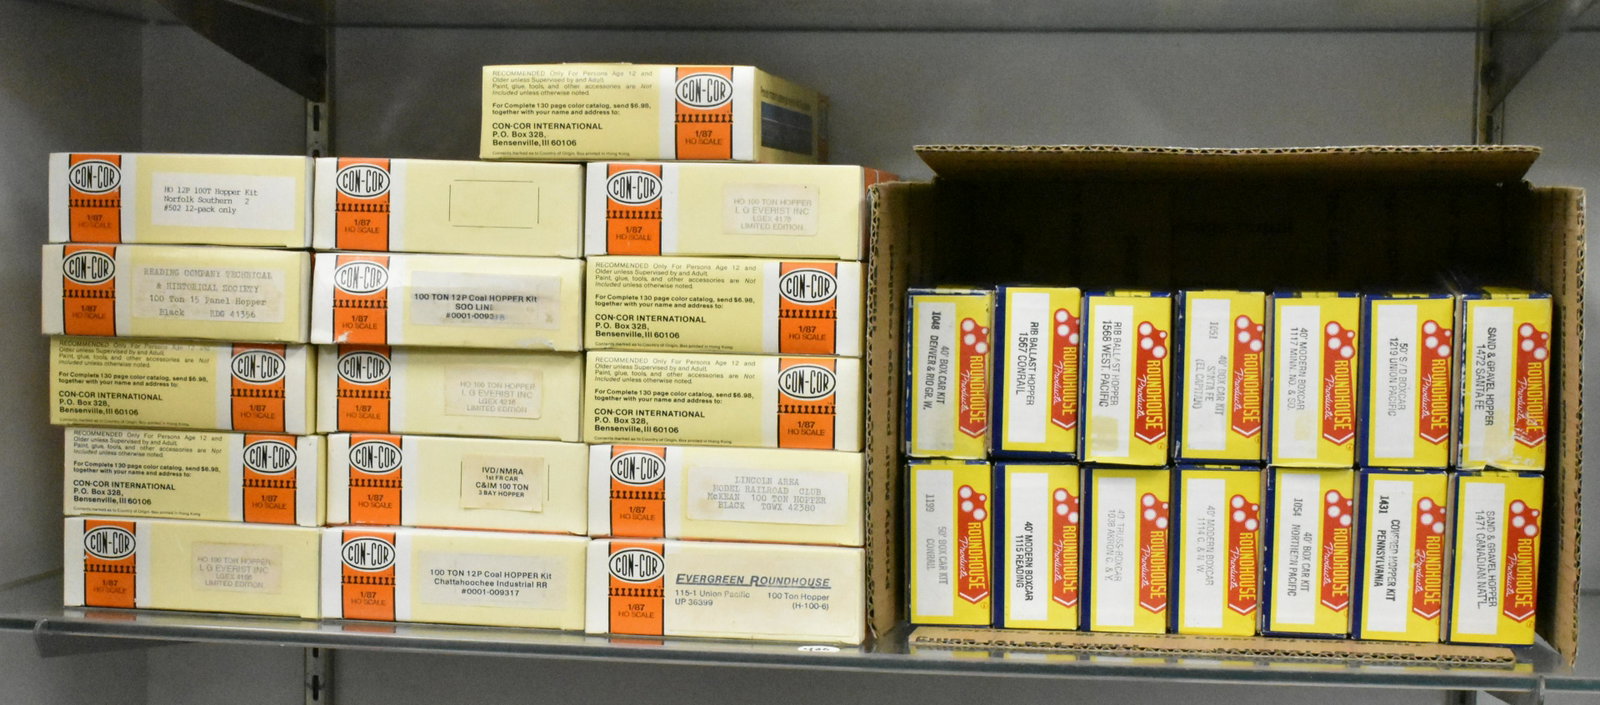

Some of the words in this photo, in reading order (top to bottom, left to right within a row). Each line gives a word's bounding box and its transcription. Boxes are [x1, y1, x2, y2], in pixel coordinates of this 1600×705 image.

[682, 79, 727, 103] CON-COR
[75, 166, 115, 188] CON-COR
[342, 170, 383, 193] CON-COR
[613, 176, 655, 200] CON-COR
[164, 186, 173, 194] HO
[215, 188, 241, 196] Hopper
[164, 196, 194, 204] Norfolk
[198, 196, 233, 205] Southern
[219, 206, 236, 214] only
[68, 257, 109, 278] CON-COR
[341, 267, 382, 290] CON-COR
[786, 273, 830, 298] CON-COR
[235, 298, 266, 306] Hopper
[636, 315, 706, 323] INTERNATIONAL
[931, 311, 941, 330] 1048
[1030, 322, 1039, 335] RIB
[1019, 332, 1028, 353] 1567
[1103, 321, 1112, 342] 1568
[1487, 328, 1496, 351] SAND
[927, 335, 938, 365] DENVER
[1028, 338, 1038, 371] BALLAST
[1389, 338, 1398, 355] 1219
[1476, 344, 1486, 366] 1472
[238, 355, 279, 378] CON-COR
[344, 357, 384, 380] CON-COR
[1298, 342, 1307, 377] MODERN
[1389, 358, 1397, 383] UNION
[785, 370, 829, 394] CON-COR
[1016, 355, 1027, 395] CONRAIL
[1062, 347, 1077, 416] ROUNDHOUSE
[1475, 368, 1485, 399] SANTA
[1486, 361, 1495, 392] GRAVEL
[98, 392, 162, 400] INTERNATIONAL
[961, 370, 970, 413] Products
[970, 355, 986, 424] ROUNDHOUSE
[1026, 374, 1035, 405] HOPPER
[1099, 374, 1109, 407] PACIFIC
[1110, 375, 1120, 405] HOPPER
[1146, 360, 1162, 430] ROUNDHOUSE
[1243, 354, 1259, 423] ROUNDHOUSE
[1297, 379, 1306, 410] BOXCAR
[1334, 360, 1351, 430] ROUNDHOUSE
[1388, 385, 1397, 416] PACIFIC
[1431, 359, 1448, 429] ROUNDHOUSE
[636, 410, 705, 418] INTERNATIONAL
[1475, 400, 1484, 410] FE
[1485, 394, 1494, 425] HOPPER
[250, 446, 290, 469] CON-COR
[355, 446, 395, 469] CON-COR
[617, 458, 659, 481] CON-COR
[482, 467, 524, 475] IVD/NMRA
[735, 477, 772, 485] LINCOLN
[713, 485, 740, 493] MODEL
[745, 486, 789, 494] RAILROAD
[926, 494, 934, 512] 1199
[1293, 498, 1302, 516] 1054
[1379, 496, 1389, 513] 1431
[1475, 510, 1484, 530] 1471
[91, 532, 129, 554] CON-COR
[348, 543, 388, 565] CON-COR
[616, 554, 657, 578] CON-COR
[968, 522, 985, 589] ROUNDHOUSE
[1063, 526, 1077, 593] ROUNDHOUSE
[1150, 531, 1165, 599] ROUNDHOUSE
[1239, 533, 1256, 600] ROUNDHOUSE
[1332, 529, 1348, 597] ROUNDHOUSE
[1374, 530, 1386, 587] PENNSYLVANIA
[1476, 533, 1486, 580] CANADIAN
[1487, 543, 1496, 573] GRAVEL
[504, 571, 538, 579] HOPPER
[1016, 554, 1024, 588] READING
[1230, 546, 1239, 590] Products
[1424, 536, 1441, 605] ROUNDHOUSE
[1515, 539, 1532, 607] ROUNDHOUSE
[434, 578, 494, 587] Chattahoochee
[496, 580, 534, 588] Industrial
[676, 574, 744, 584] EVERGREEN
[750, 576, 830, 587] ROUNDHOUSE
[1025, 570, 1033, 601] BOXCAR
[1287, 567, 1297, 596] PACIFIC
[1488, 575, 1497, 607] HOPPER
[793, 602, 829, 610] (H-100-6)
[800, 593, 829, 601] Hopper
